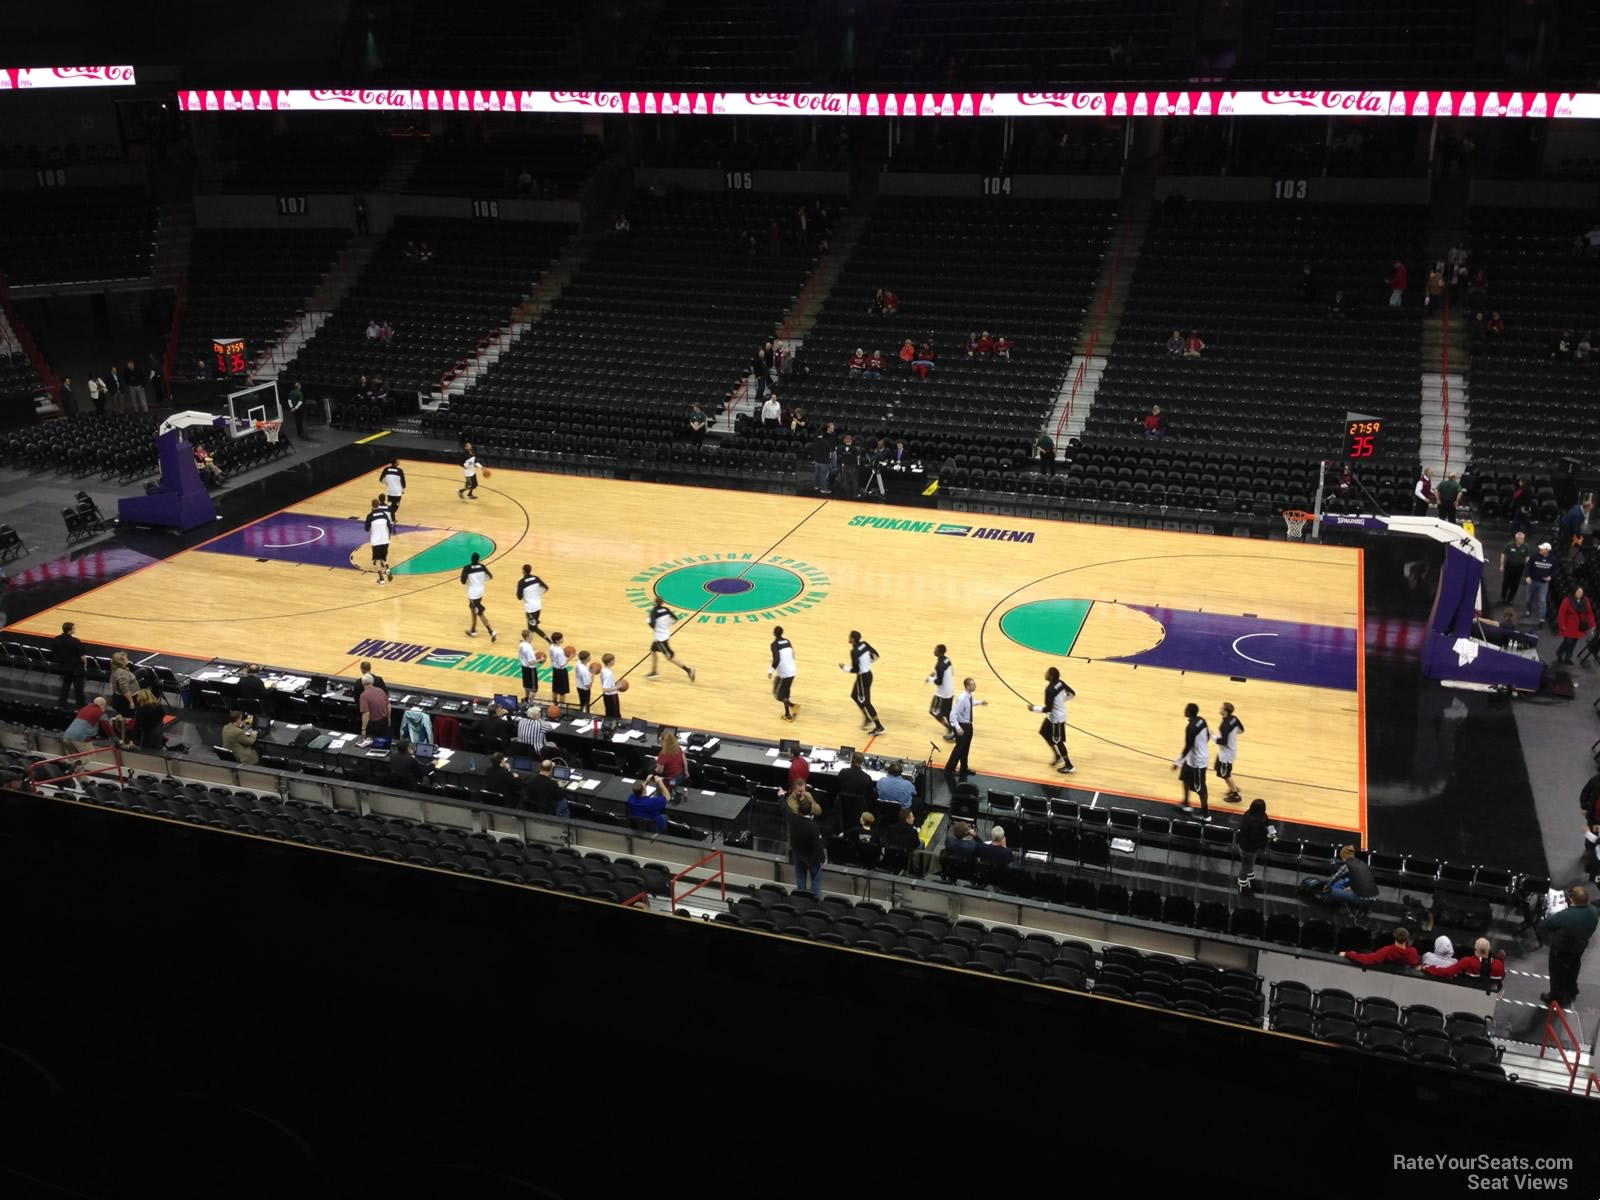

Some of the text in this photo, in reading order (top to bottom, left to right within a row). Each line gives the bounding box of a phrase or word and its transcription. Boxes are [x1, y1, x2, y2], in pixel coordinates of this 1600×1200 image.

[36, 169, 66, 187] 108
[726, 172, 752, 190] 105
[983, 176, 1012, 195] 104
[1274, 180, 1308, 199] 103
[279, 197, 305, 214] 107
[473, 200, 498, 218] 106
[231, 353, 246, 373] 35
[1349, 422, 1380, 435] 27:59
[1350, 436, 1375, 457] 35
[848, 515, 1036, 544] SPOKANE ARENA
[346, 638, 432, 663] ARENA
